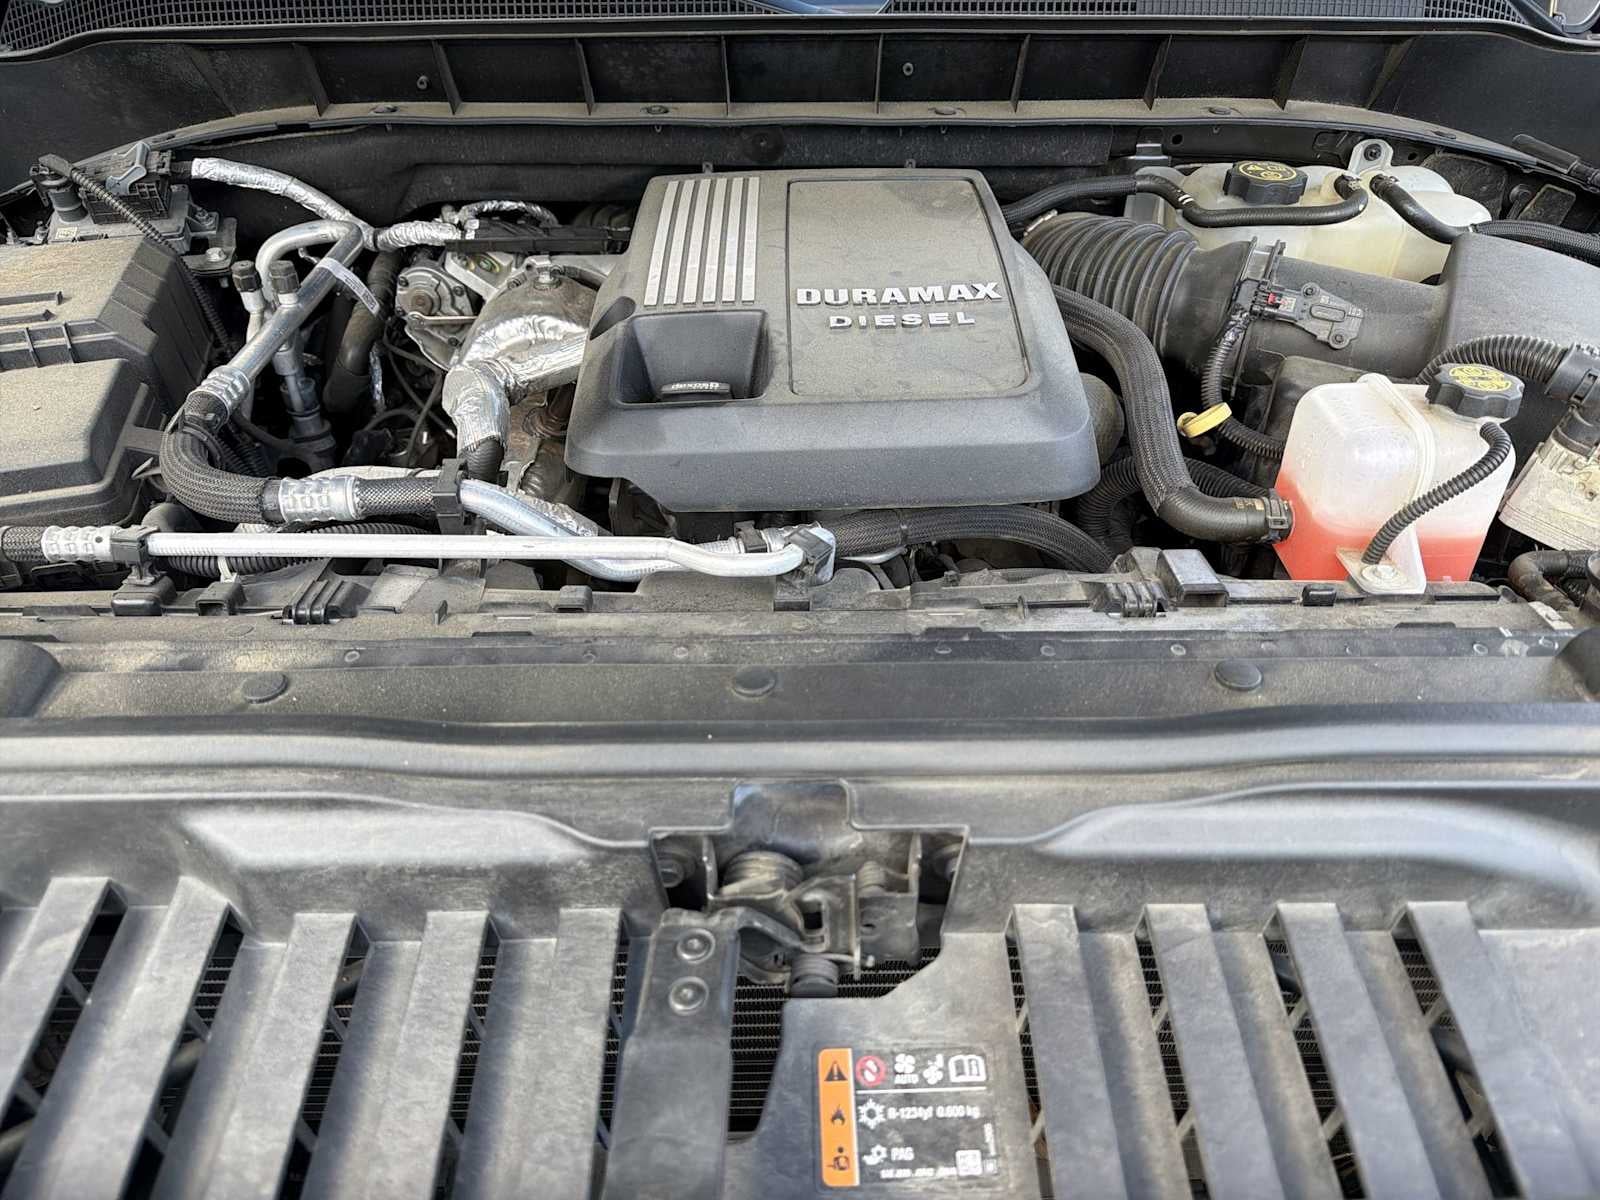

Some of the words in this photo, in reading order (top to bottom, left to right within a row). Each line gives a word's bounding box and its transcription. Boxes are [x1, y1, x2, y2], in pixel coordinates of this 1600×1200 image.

[796, 282, 1002, 306] DURAMAX
[829, 311, 976, 329] DIESEL
[891, 1147, 914, 1161] PAG
